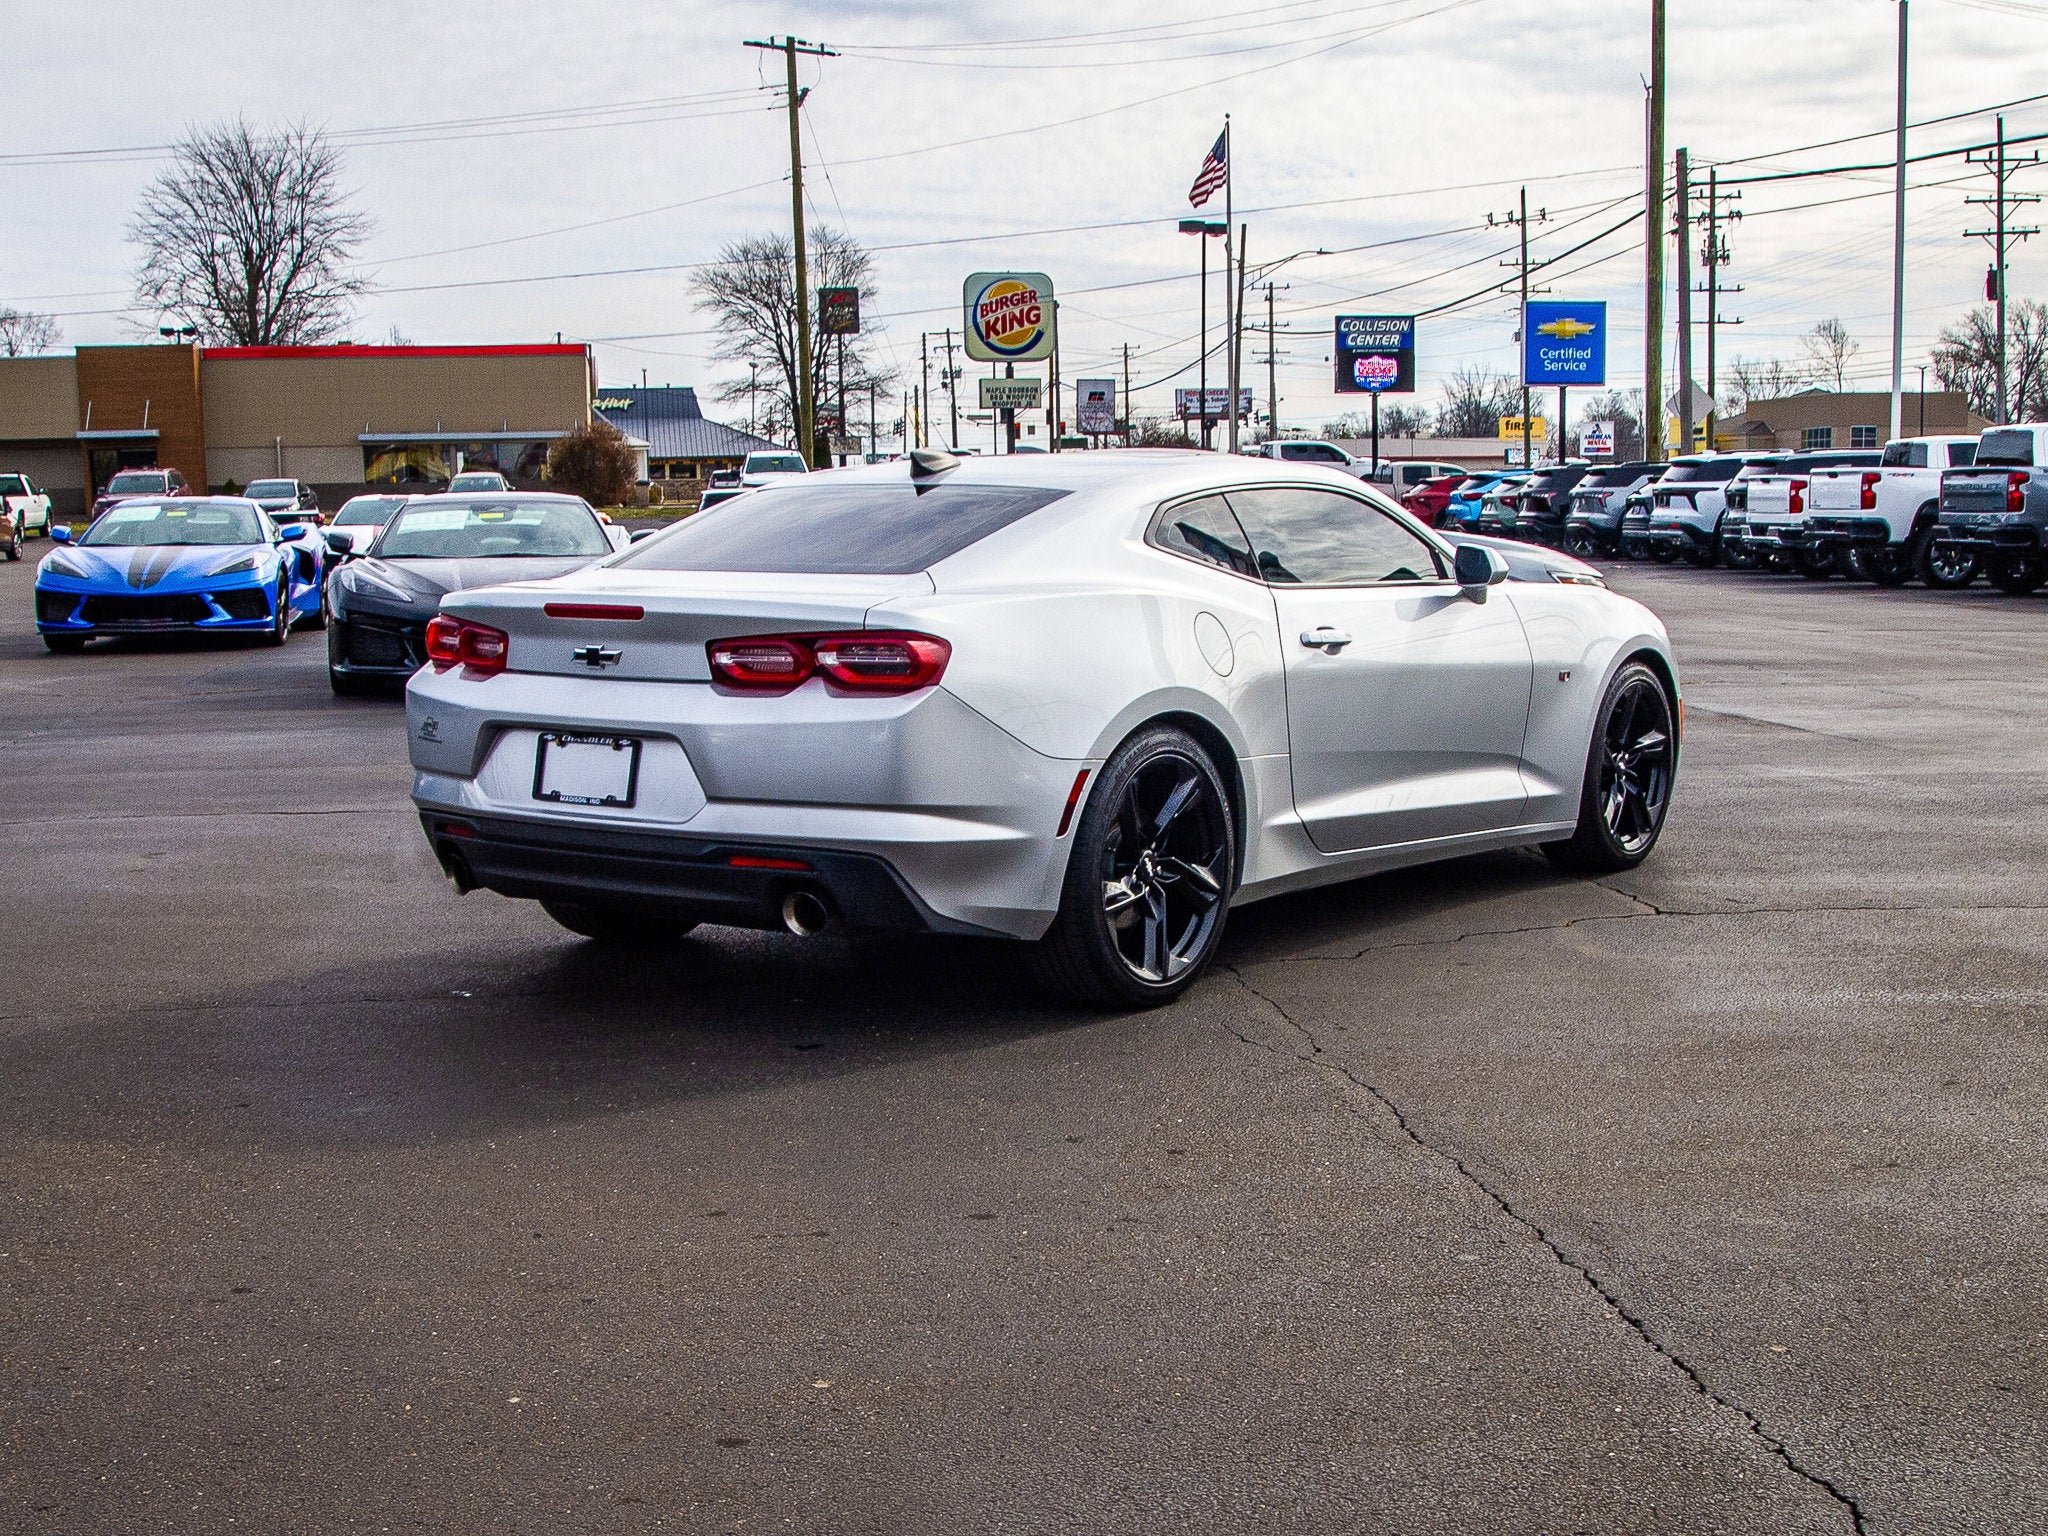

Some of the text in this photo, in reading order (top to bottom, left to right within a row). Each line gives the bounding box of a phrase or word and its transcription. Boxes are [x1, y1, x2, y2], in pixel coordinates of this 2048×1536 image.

[980, 289, 1039, 319] BURGER
[984, 305, 1041, 340] KING
[1340, 319, 1410, 332] COLLISION
[1347, 333, 1400, 346] CENTER
[1540, 347, 1592, 359] Certified
[1544, 360, 1587, 371] Service
[561, 734, 614, 745] CHANDLER
